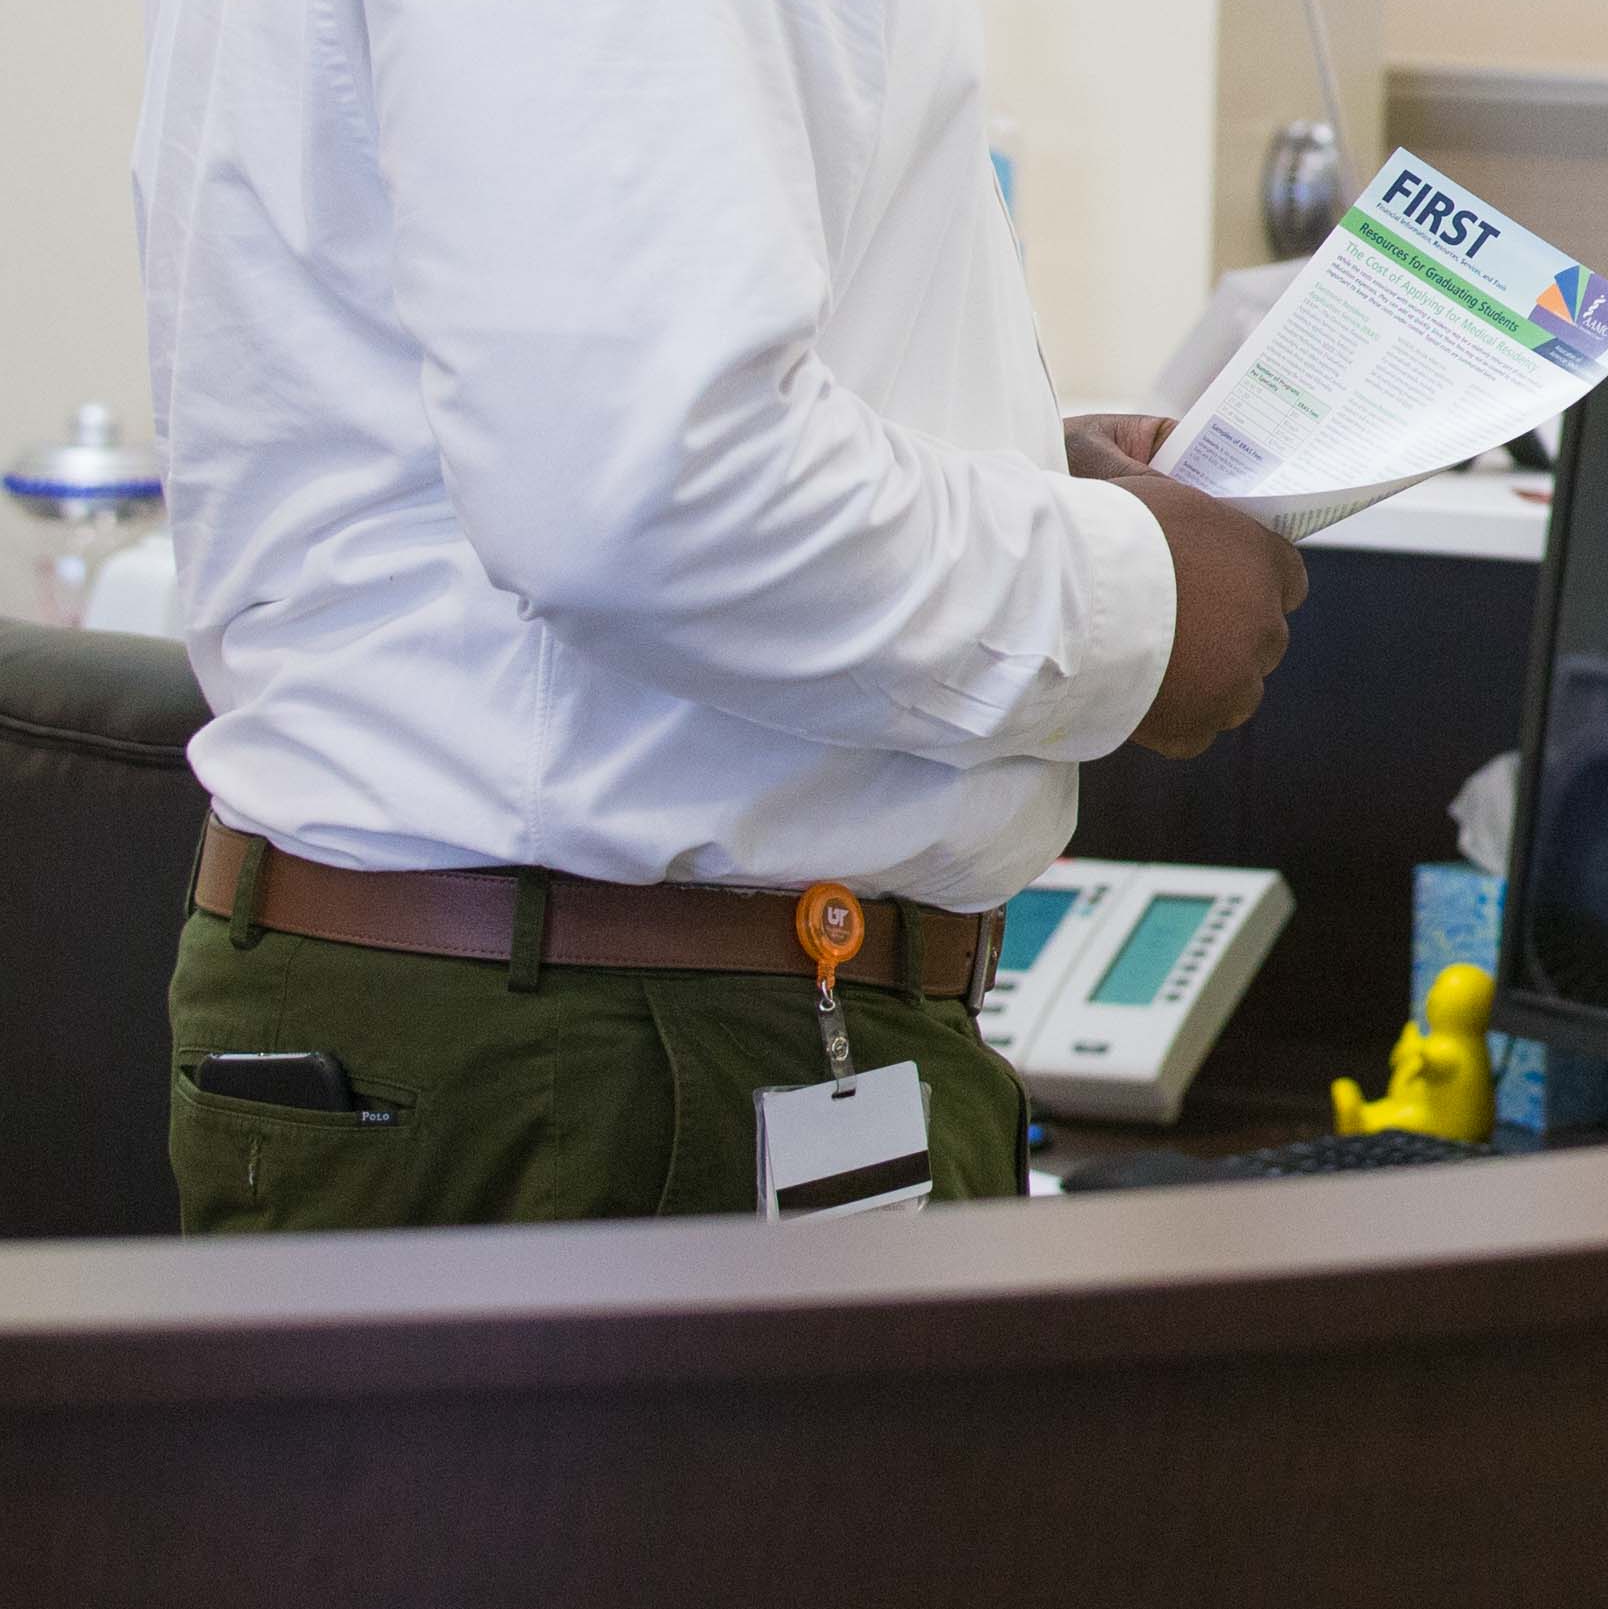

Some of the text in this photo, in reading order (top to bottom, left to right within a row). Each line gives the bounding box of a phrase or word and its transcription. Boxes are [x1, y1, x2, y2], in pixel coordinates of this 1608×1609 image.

[1381, 169, 1501, 259] FIRST
[1343, 241, 1364, 260] The
[1364, 254, 1389, 276] Cost
[1387, 270, 1403, 285] of
[1398, 278, 1447, 317] Applying
[1445, 307, 1462, 324] for
[1460, 317, 1498, 346] Medical
[1358, 222, 1410, 261] Resources
[1407, 255, 1426, 271] for
[1422, 266, 1480, 308] Graduating
[1477, 301, 1520, 332] Students
[1210, 423, 1233, 441] Samples
[1238, 441, 1253, 454] ERAS
